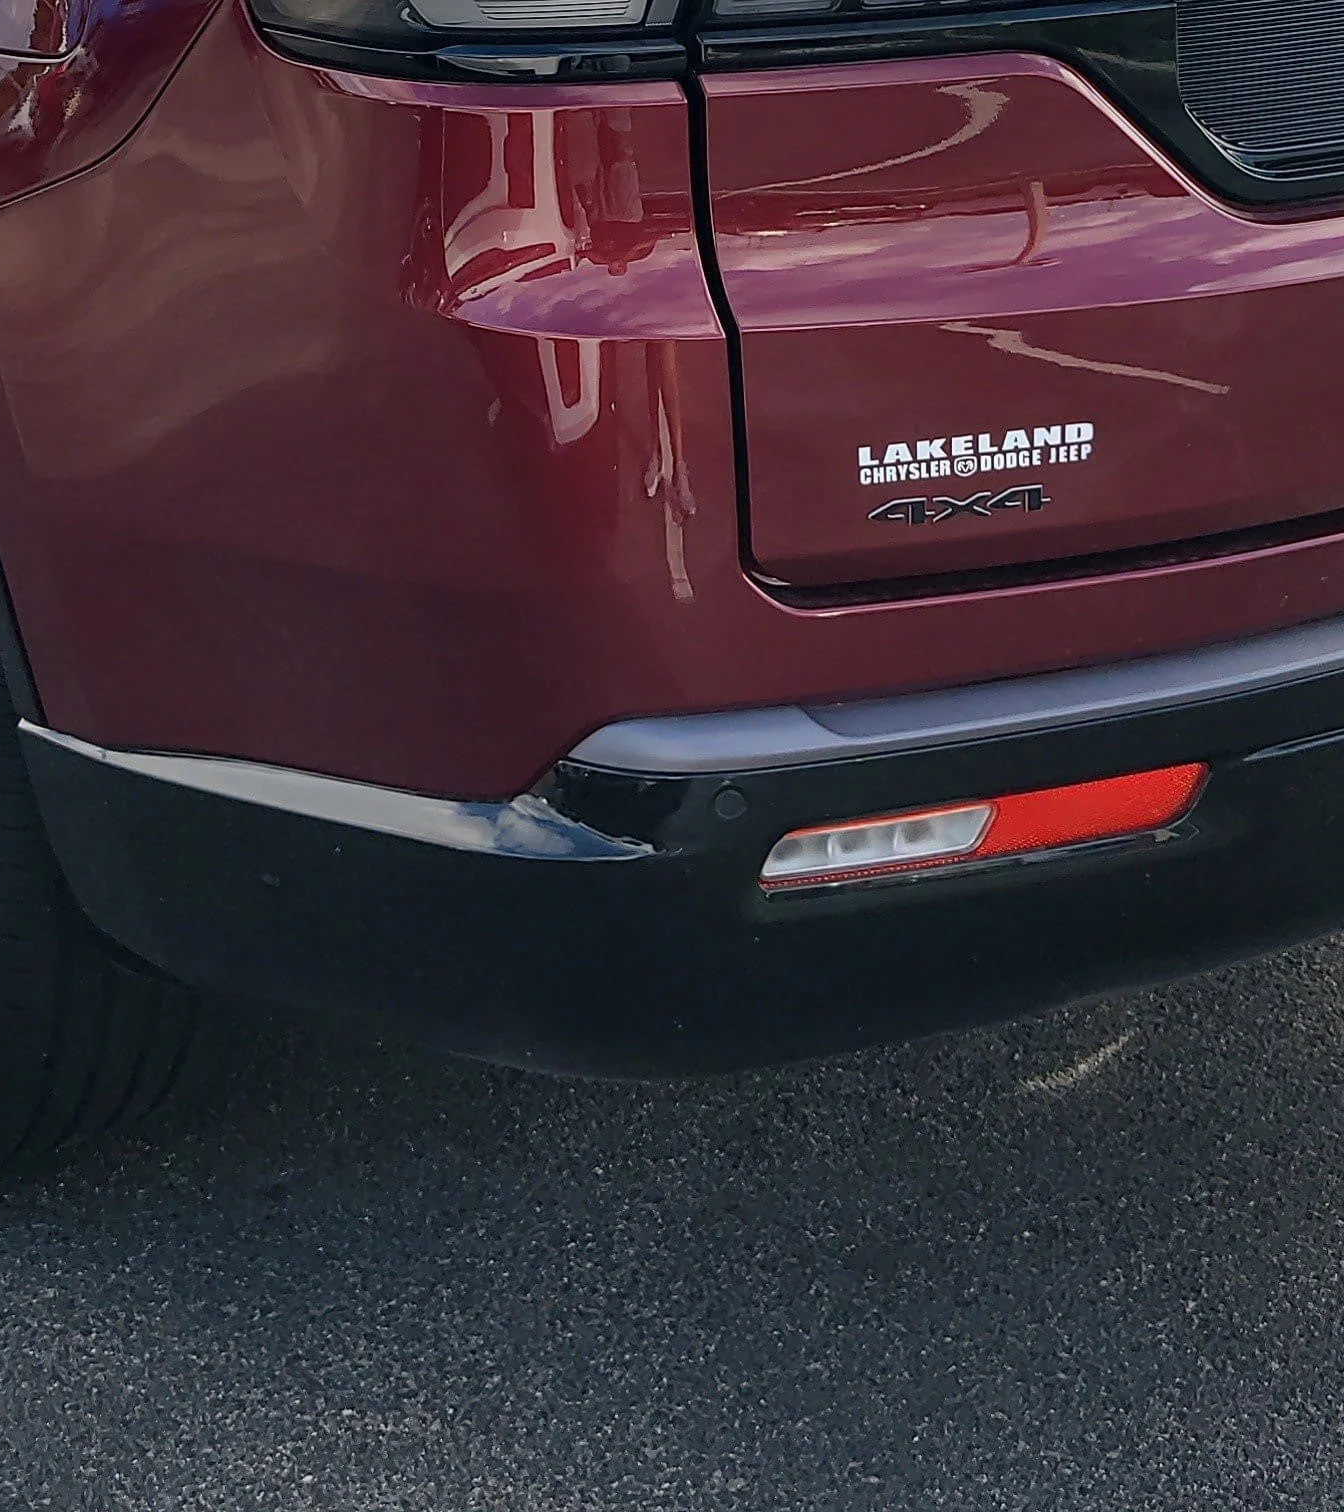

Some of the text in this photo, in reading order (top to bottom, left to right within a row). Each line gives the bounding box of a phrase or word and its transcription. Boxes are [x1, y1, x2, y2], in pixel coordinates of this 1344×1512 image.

[858, 422, 1094, 468] LAKELAND
[859, 442, 1093, 486] CHRYSLER DODGE JEEP
